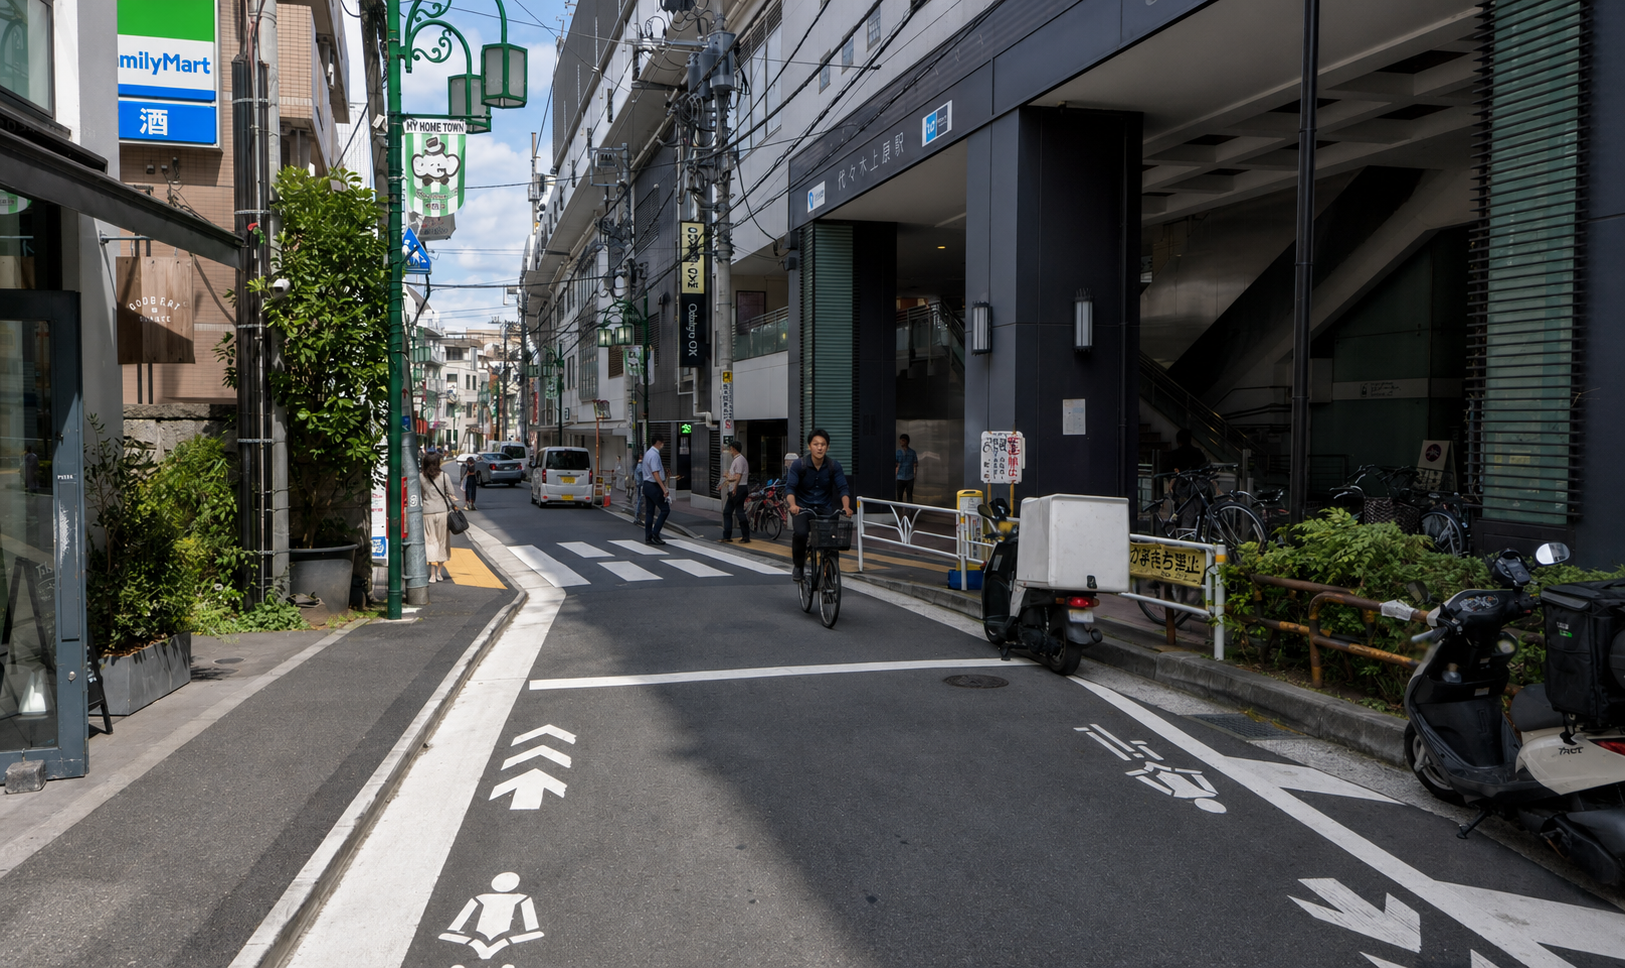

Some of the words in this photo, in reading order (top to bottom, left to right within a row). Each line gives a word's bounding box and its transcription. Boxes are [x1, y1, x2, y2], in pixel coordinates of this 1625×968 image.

[117, 51, 211, 76] milyMart
[139, 107, 169, 136] 酒
[837, 131, 905, 191] 代々木上原駅
